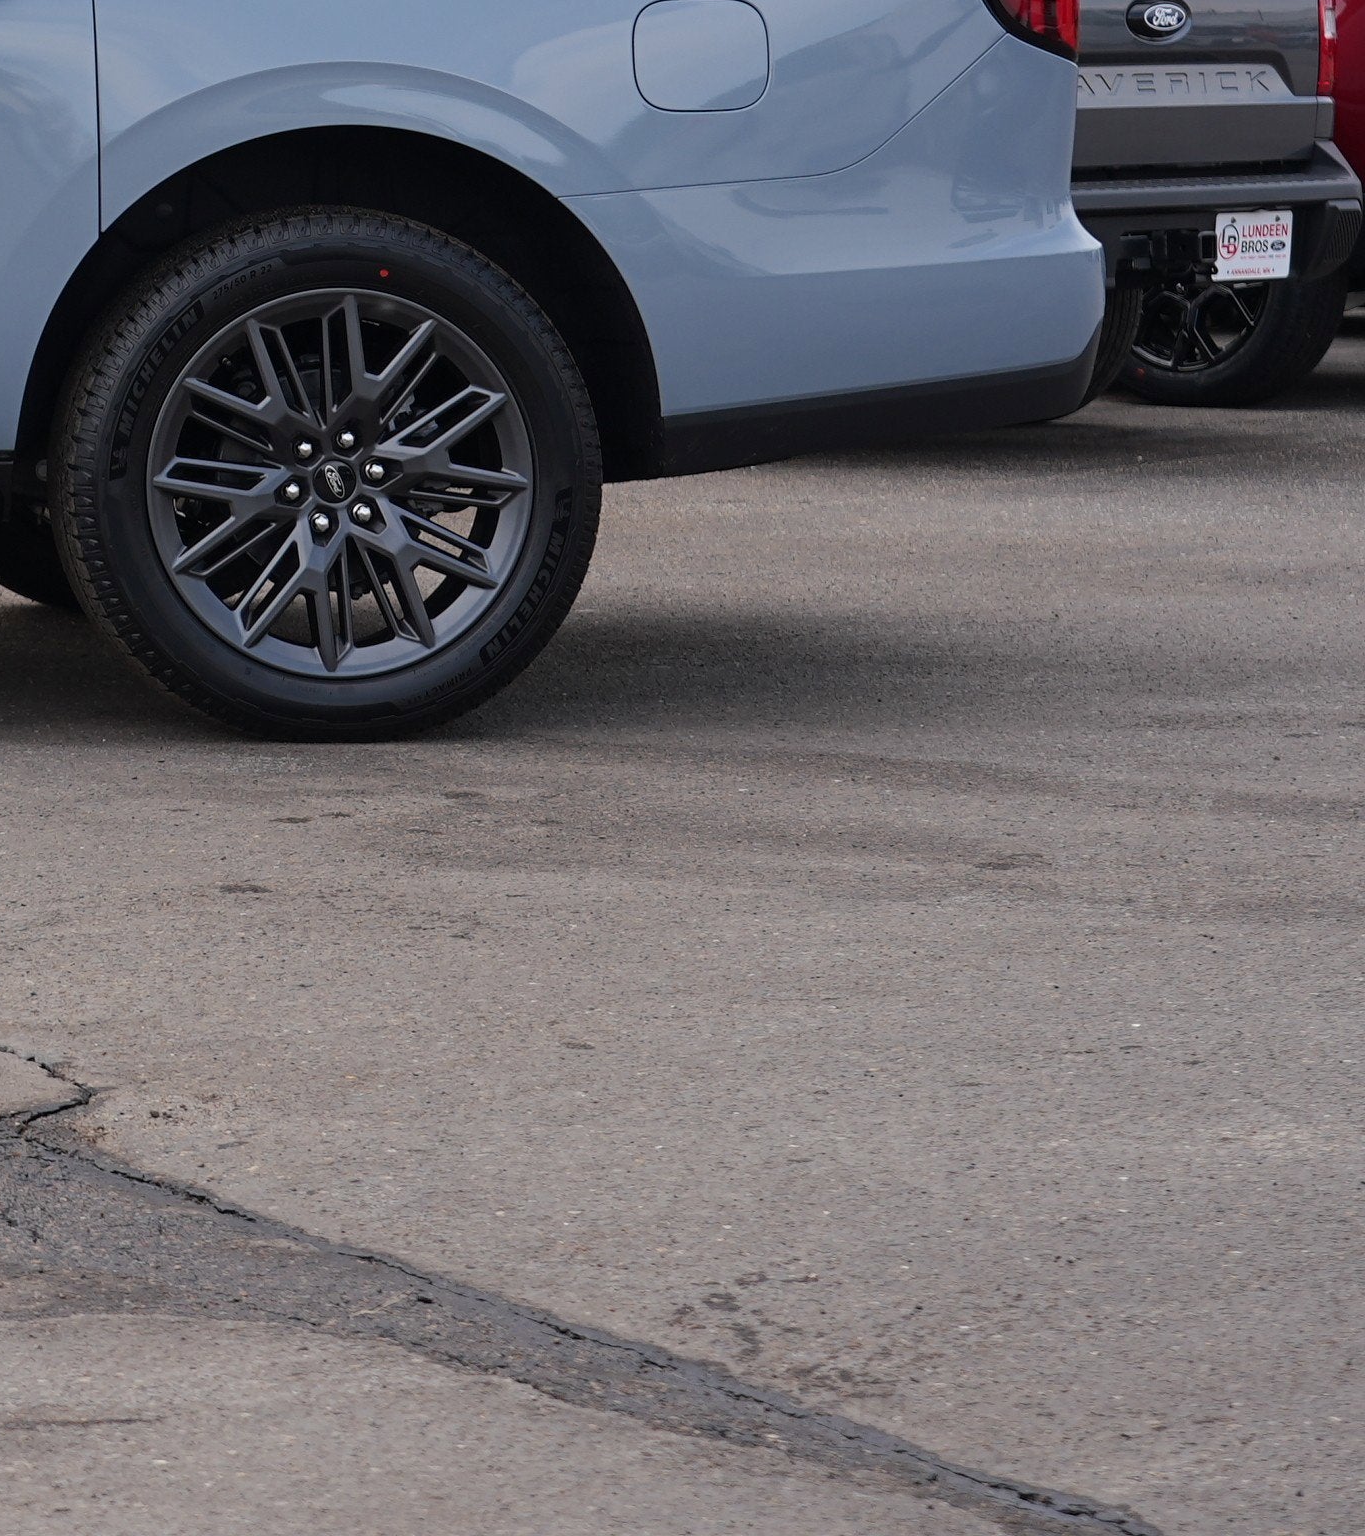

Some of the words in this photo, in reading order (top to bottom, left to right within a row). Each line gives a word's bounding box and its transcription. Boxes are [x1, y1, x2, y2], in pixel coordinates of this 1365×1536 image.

[1152, 7, 1179, 26] Ford
[1242, 224, 1289, 238] LUNDEEN
[1241, 240, 1269, 253] BROS
[211, 272, 248, 300] 275/50
[248, 267, 259, 280] R
[259, 261, 274, 275] 22
[118, 308, 200, 436] MICHELIN
[327, 473, 344, 499] Ford
